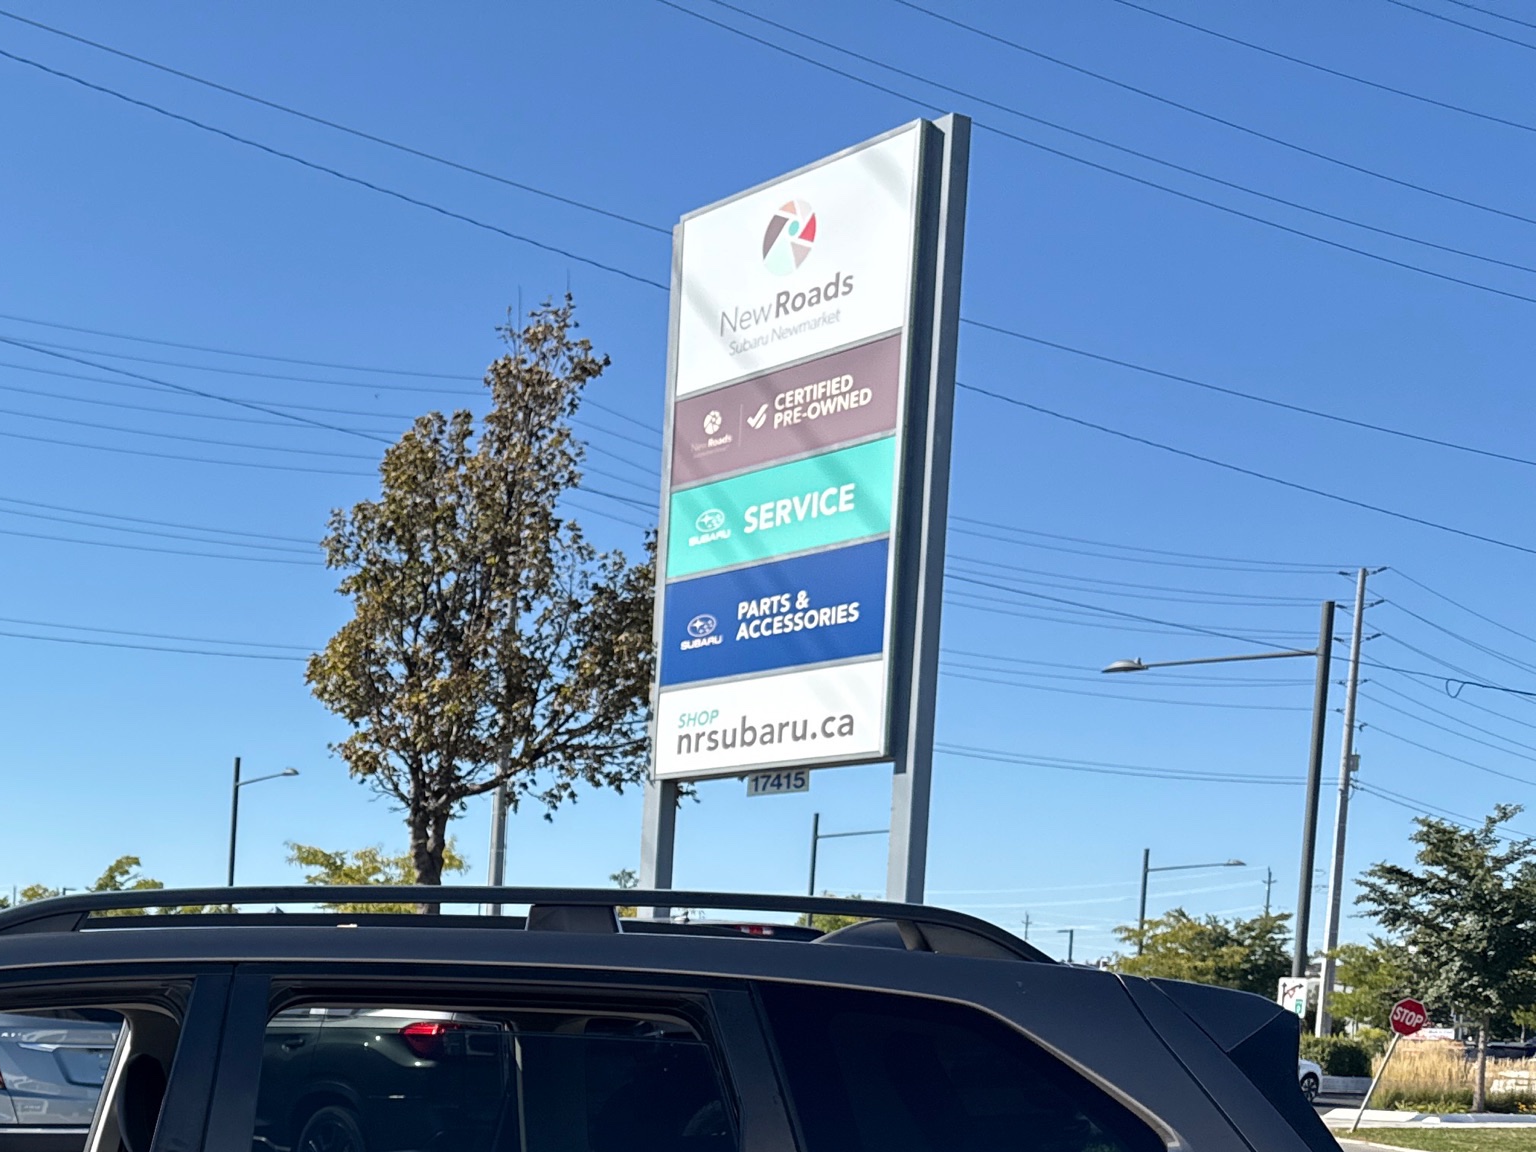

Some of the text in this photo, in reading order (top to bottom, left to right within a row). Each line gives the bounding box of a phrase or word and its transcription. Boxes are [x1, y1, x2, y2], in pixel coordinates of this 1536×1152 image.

[728, 308, 841, 357] Subaru Newmarket
[773, 387, 873, 430] PRE-OWNED
[774, 374, 854, 411] CERTIFIED
[743, 482, 856, 534] SERVICE
[688, 528, 731, 547] SUBARU
[735, 601, 861, 641] ACCESSORIES
[737, 589, 810, 621] PARTS &
[680, 634, 723, 651] SUBARU
[676, 713, 855, 755] nrsubaru.ca
[677, 708, 719, 730] SHOP
[751, 770, 806, 793] 17415
[1393, 1006, 1424, 1027] STOP
